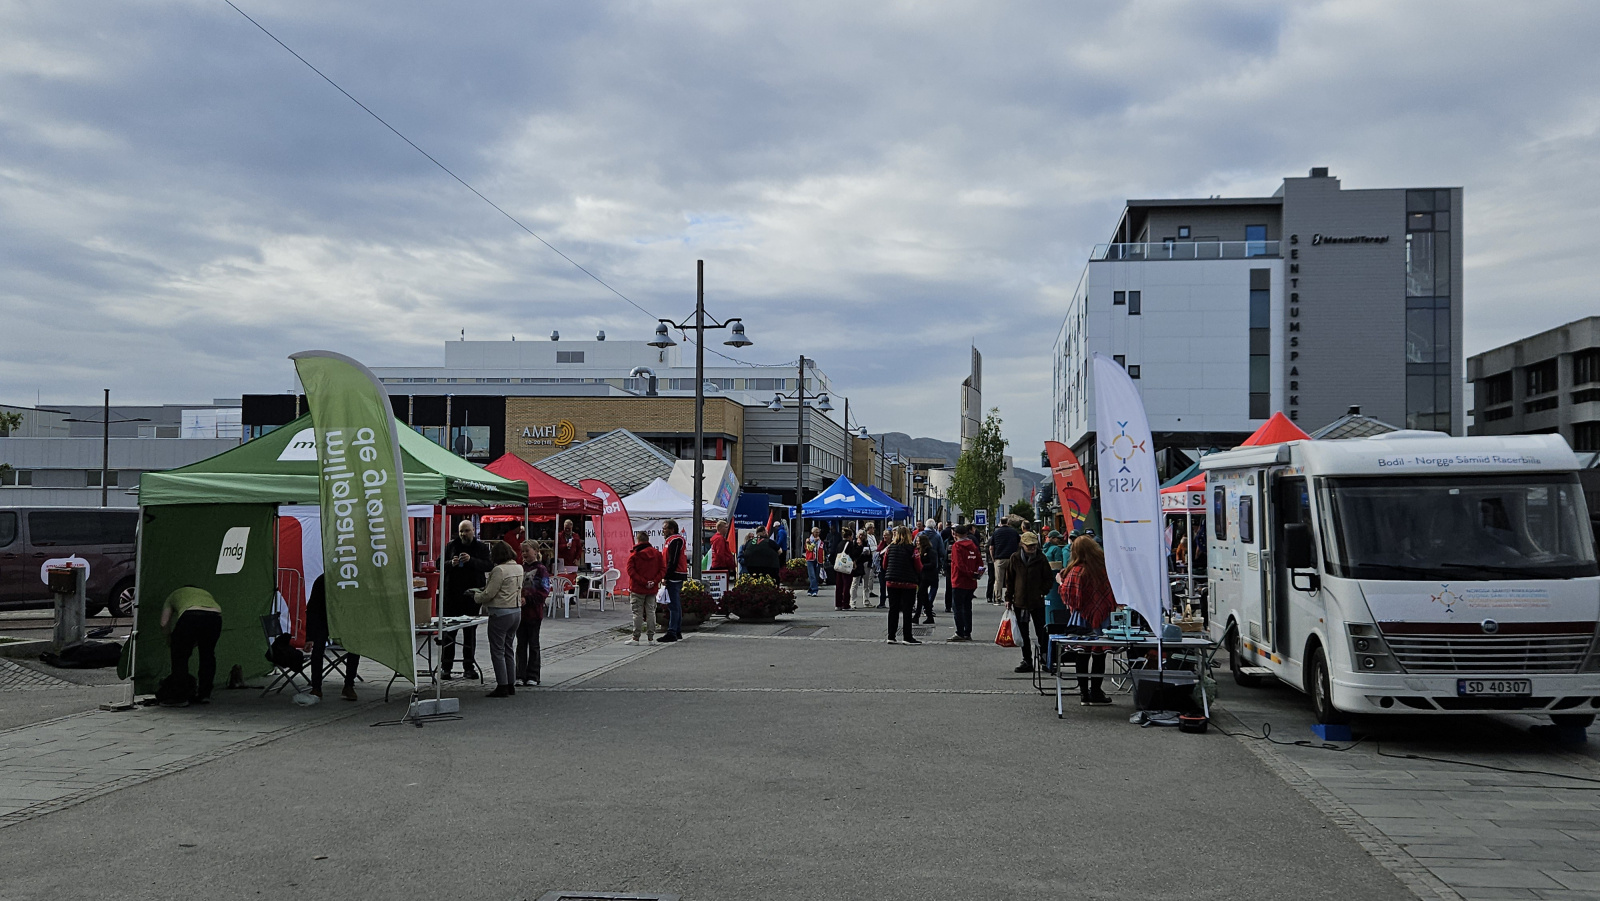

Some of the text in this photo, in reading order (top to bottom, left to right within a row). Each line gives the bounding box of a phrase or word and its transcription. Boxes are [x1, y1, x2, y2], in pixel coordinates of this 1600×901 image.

[1323, 236, 1389, 244] ManuellTerapi
[522, 424, 557, 438] AMFI
[1378, 458, 1405, 466] Bodil
[1416, 457, 1454, 467] Norgga
[222, 543, 244, 560] mdg
[1469, 682, 1528, 692] SD 40307
